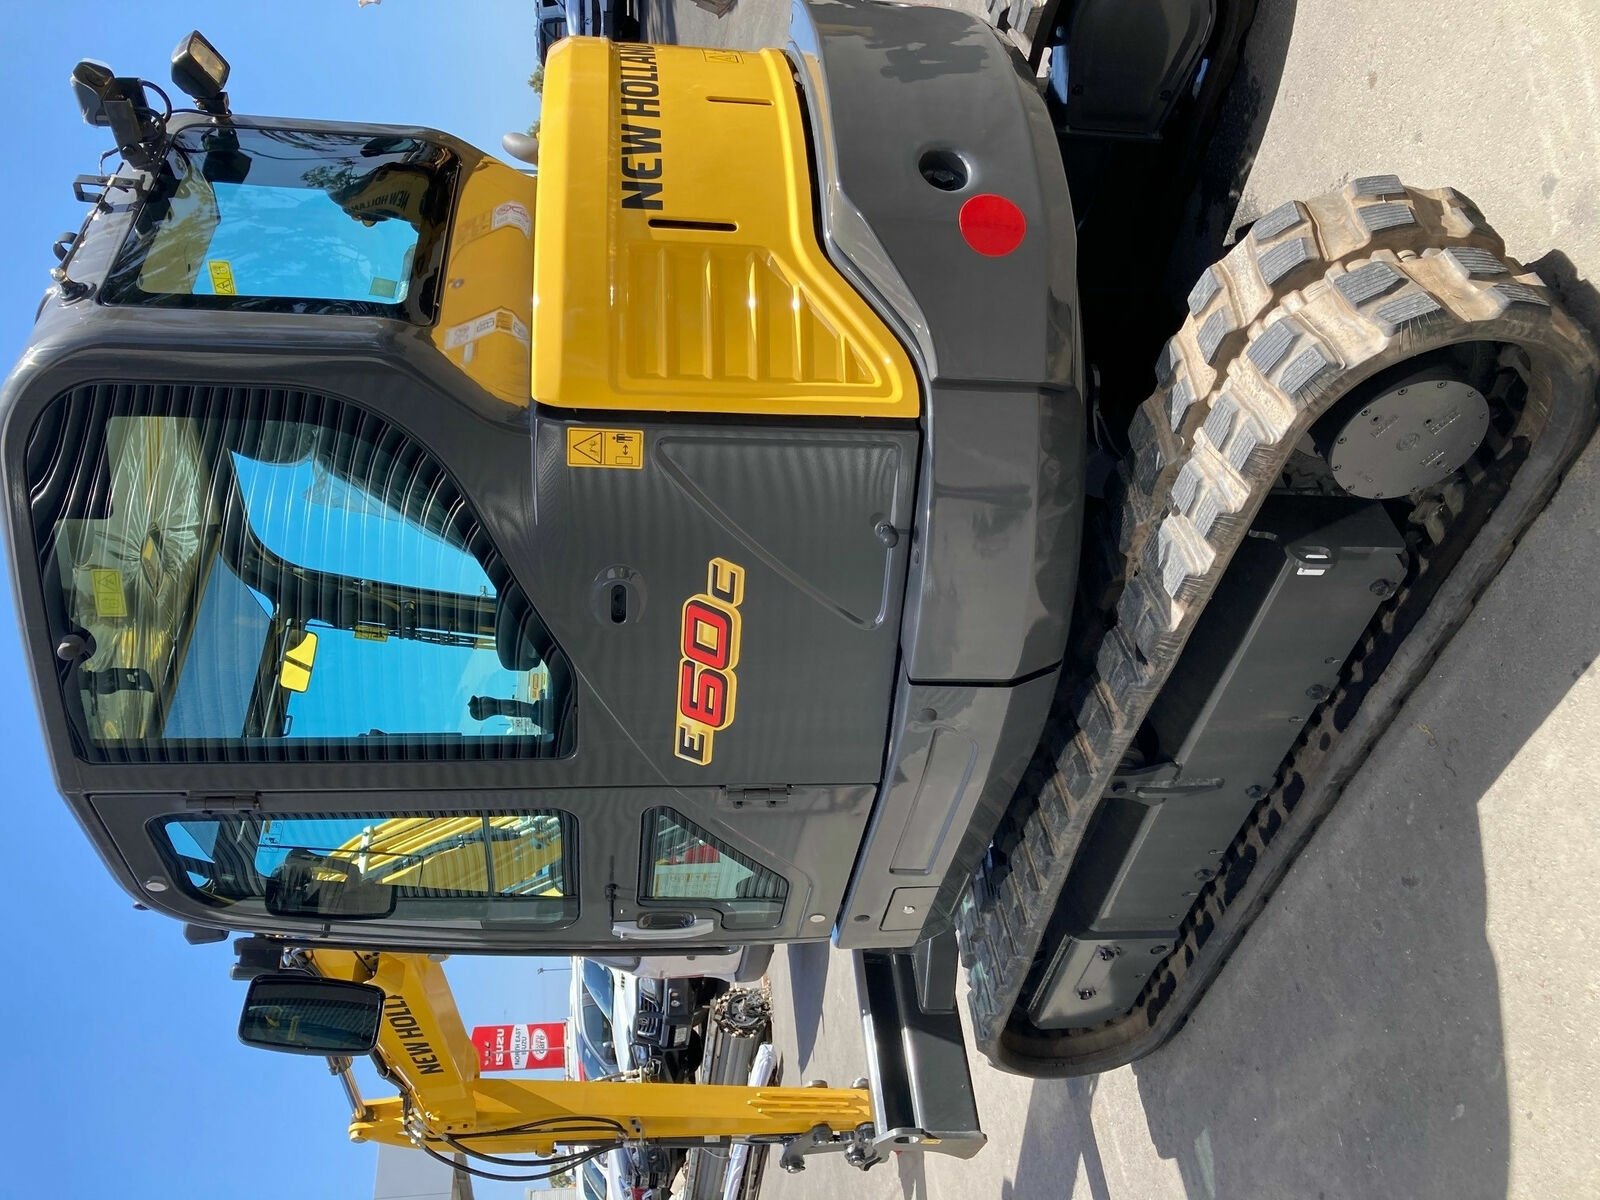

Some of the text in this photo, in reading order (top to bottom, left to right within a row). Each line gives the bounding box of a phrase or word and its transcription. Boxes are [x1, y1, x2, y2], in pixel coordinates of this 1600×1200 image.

[619, 44, 663, 211] NEW HOLLAND
[676, 559, 742, 764] E60C
[403, 1042, 444, 1075] NEW
[496, 1028, 504, 1066] ISUZU
